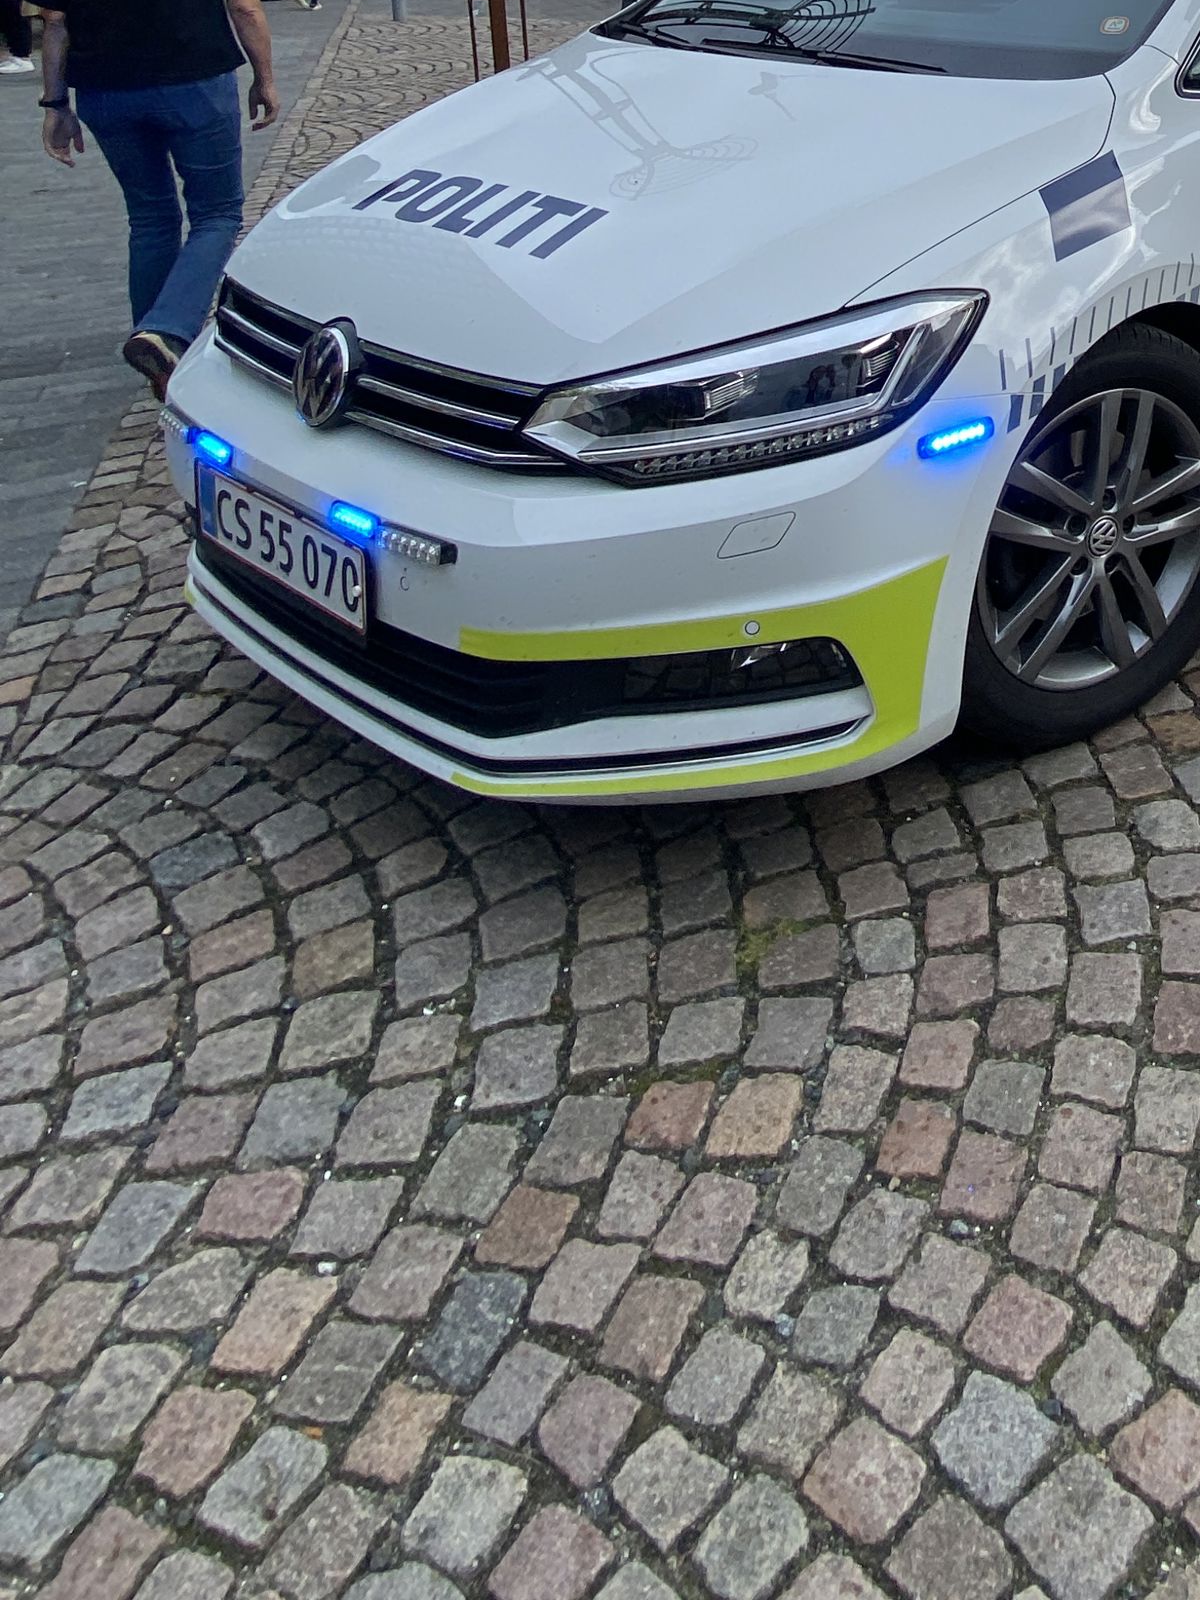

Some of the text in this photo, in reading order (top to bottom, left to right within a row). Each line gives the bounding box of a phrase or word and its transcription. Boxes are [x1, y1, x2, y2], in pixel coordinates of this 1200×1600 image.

[351, 169, 610, 260] POLITI
[217, 489, 360, 612] CS 55 070
